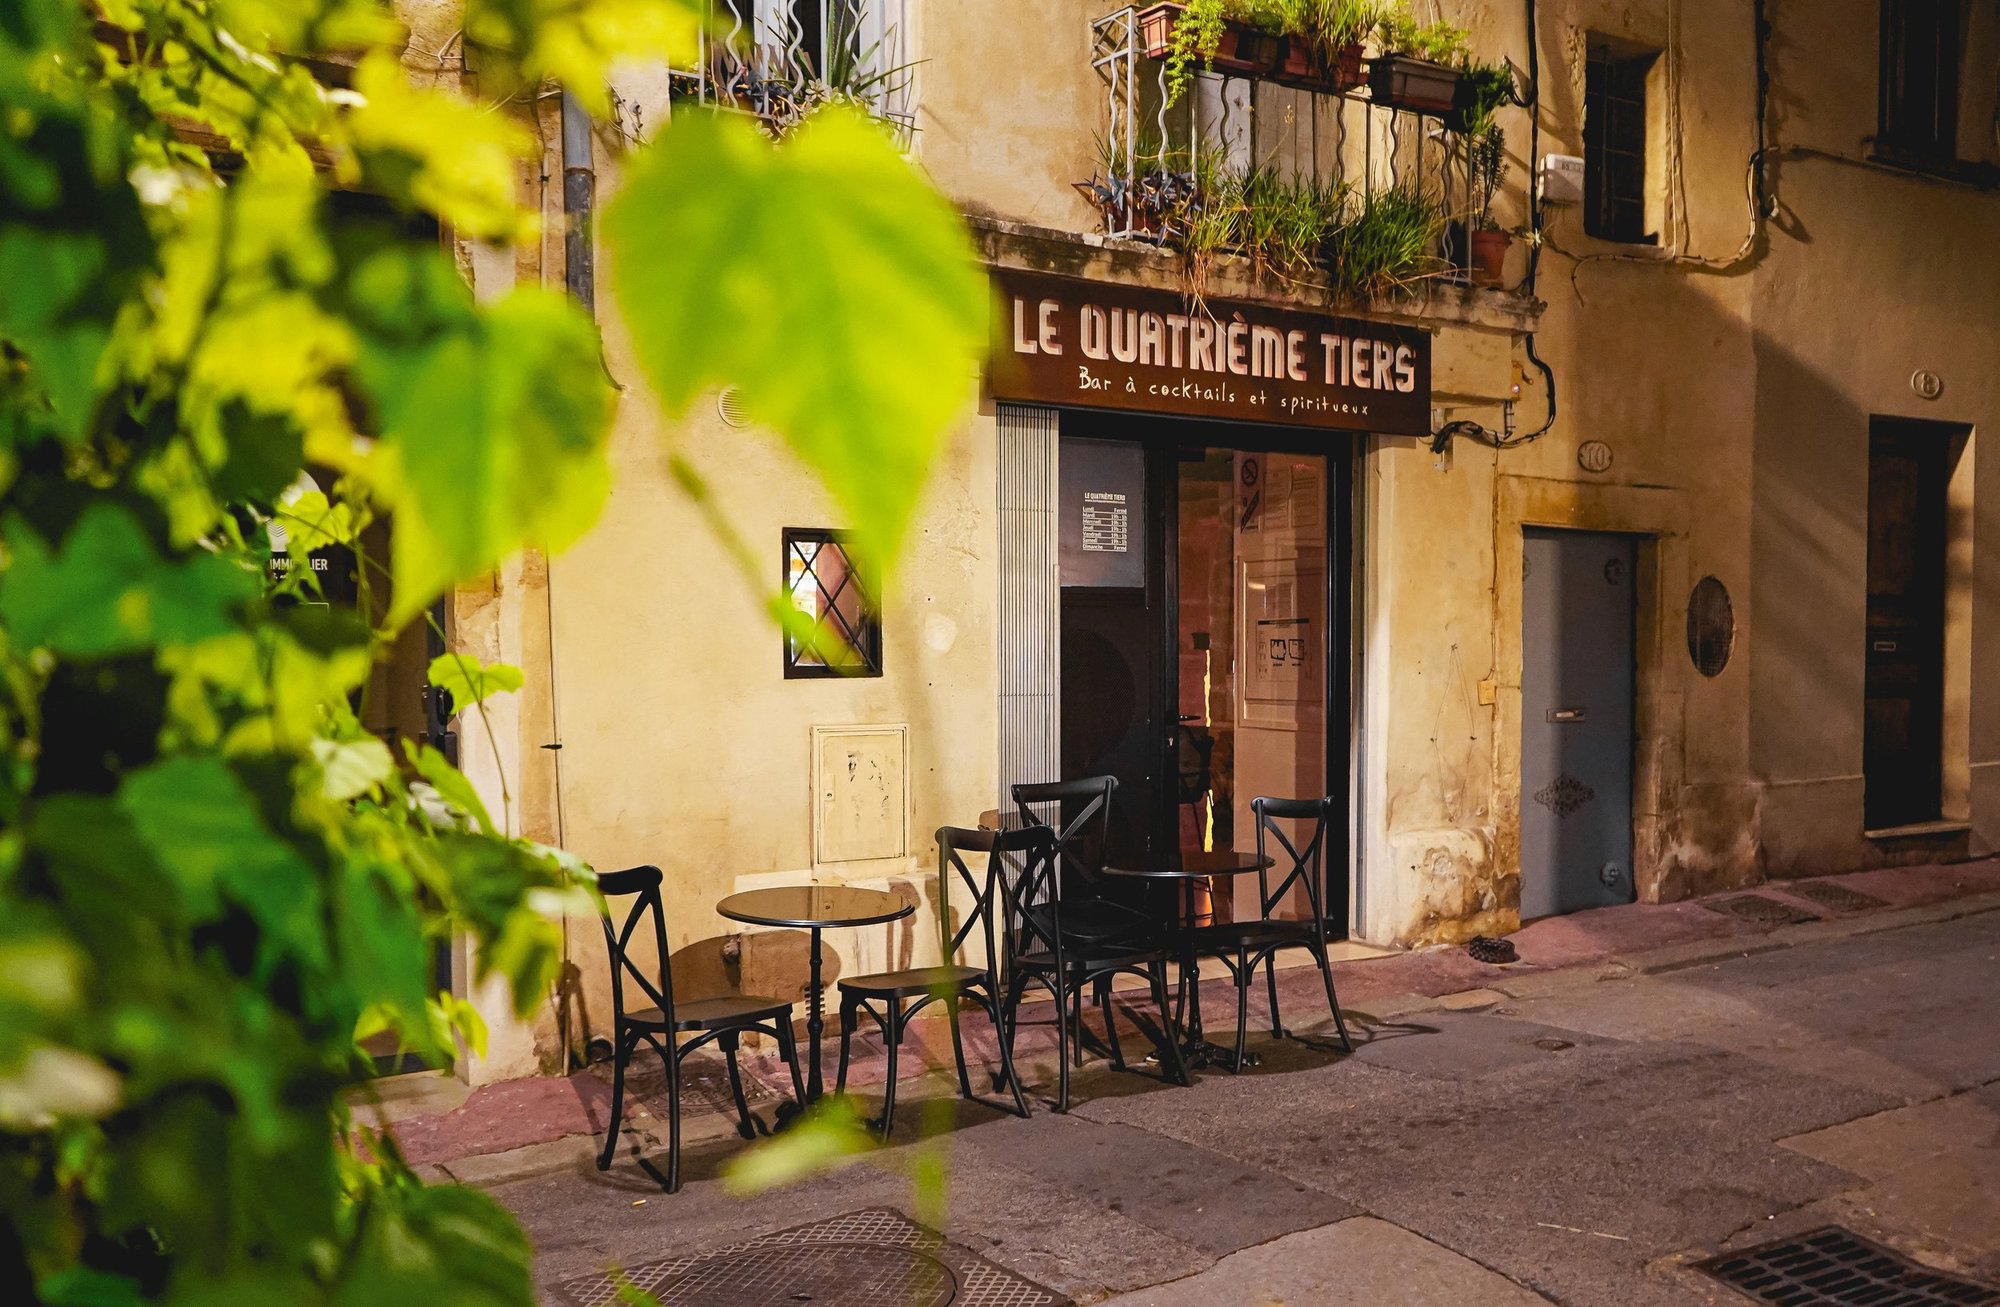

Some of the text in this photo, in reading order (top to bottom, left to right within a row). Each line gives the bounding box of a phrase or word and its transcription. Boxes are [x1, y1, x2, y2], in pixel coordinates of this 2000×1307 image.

[1012, 297, 1416, 394] LE QUATRIÈME TIERS
[1078, 365, 1369, 416] Bar à cocktails et spiritueux
[1584, 444, 1607, 468] 10
[269, 558, 328, 571] IMMIER
